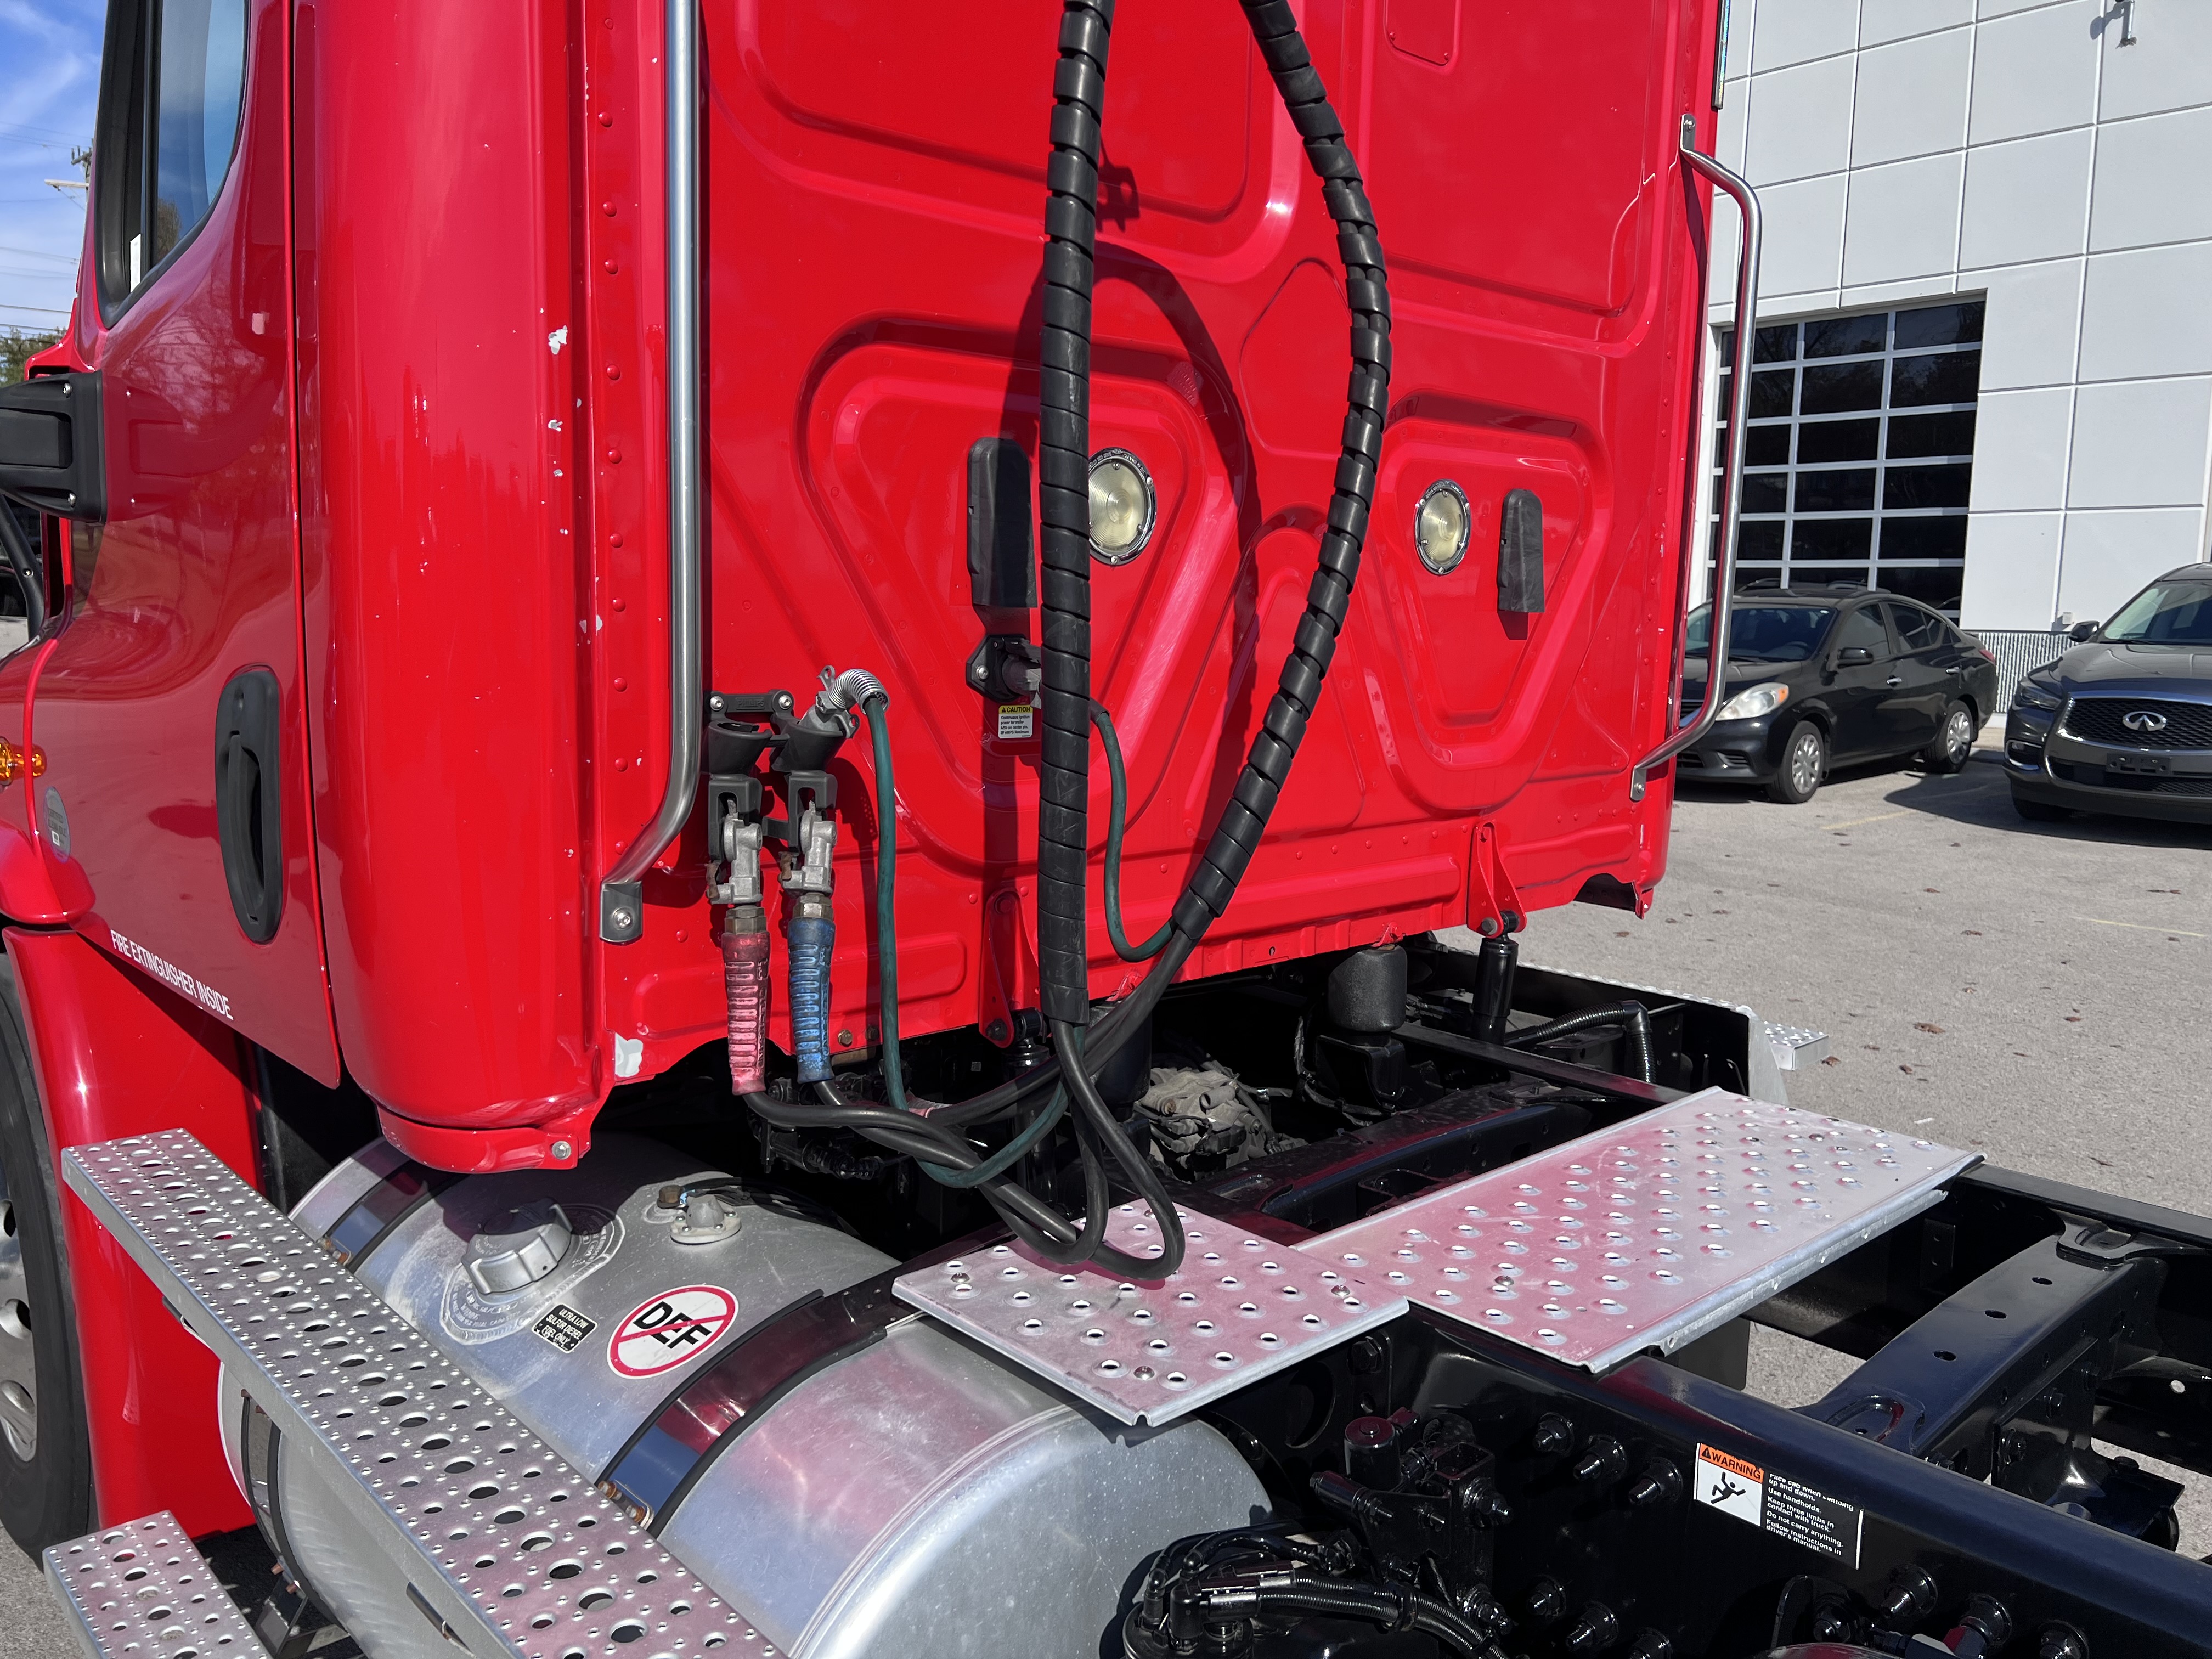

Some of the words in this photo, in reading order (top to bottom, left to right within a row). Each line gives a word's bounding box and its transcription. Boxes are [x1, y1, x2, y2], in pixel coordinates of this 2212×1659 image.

[110, 929, 132, 958] FIRE
[129, 940, 198, 999] EXTINGUISHER
[196, 980, 234, 1021] INSIDE
[549, 1314, 567, 1330] SULFUR
[563, 1324, 583, 1340] DIESEL
[558, 1308, 575, 1323] ULTRA
[573, 1316, 589, 1329] LOW
[633, 1301, 712, 1349] DEF
[555, 1333, 569, 1345] ONLY
[1712, 1452, 1761, 1480] WARNING
[1779, 1482, 1792, 1492] and
[1794, 1488, 1815, 1502] down.
[1787, 1480, 1801, 1489] cab
[1768, 1486, 1781, 1497] Use
[1783, 1493, 1822, 1514] handholds.
[1768, 1496, 1785, 1509] Keep
[1786, 1504, 1805, 1516] three
[1806, 1512, 1825, 1525] limbs
[1767, 1502, 1793, 1516] contact
[1794, 1513, 1809, 1523] with
[1810, 1520, 1831, 1533] truck.
[1767, 1510, 1777, 1519] Do
[1778, 1516, 1790, 1525] not
[1791, 1521, 1809, 1533] carry
[1810, 1530, 1844, 1548] anything.
[1766, 1519, 1790, 1533] Follow
[1791, 1529, 1832, 1551] instructions
[1834, 1548, 1841, 1556] in
[1766, 1525, 1792, 1539] driver's
[1793, 1537, 1821, 1553] manual.
